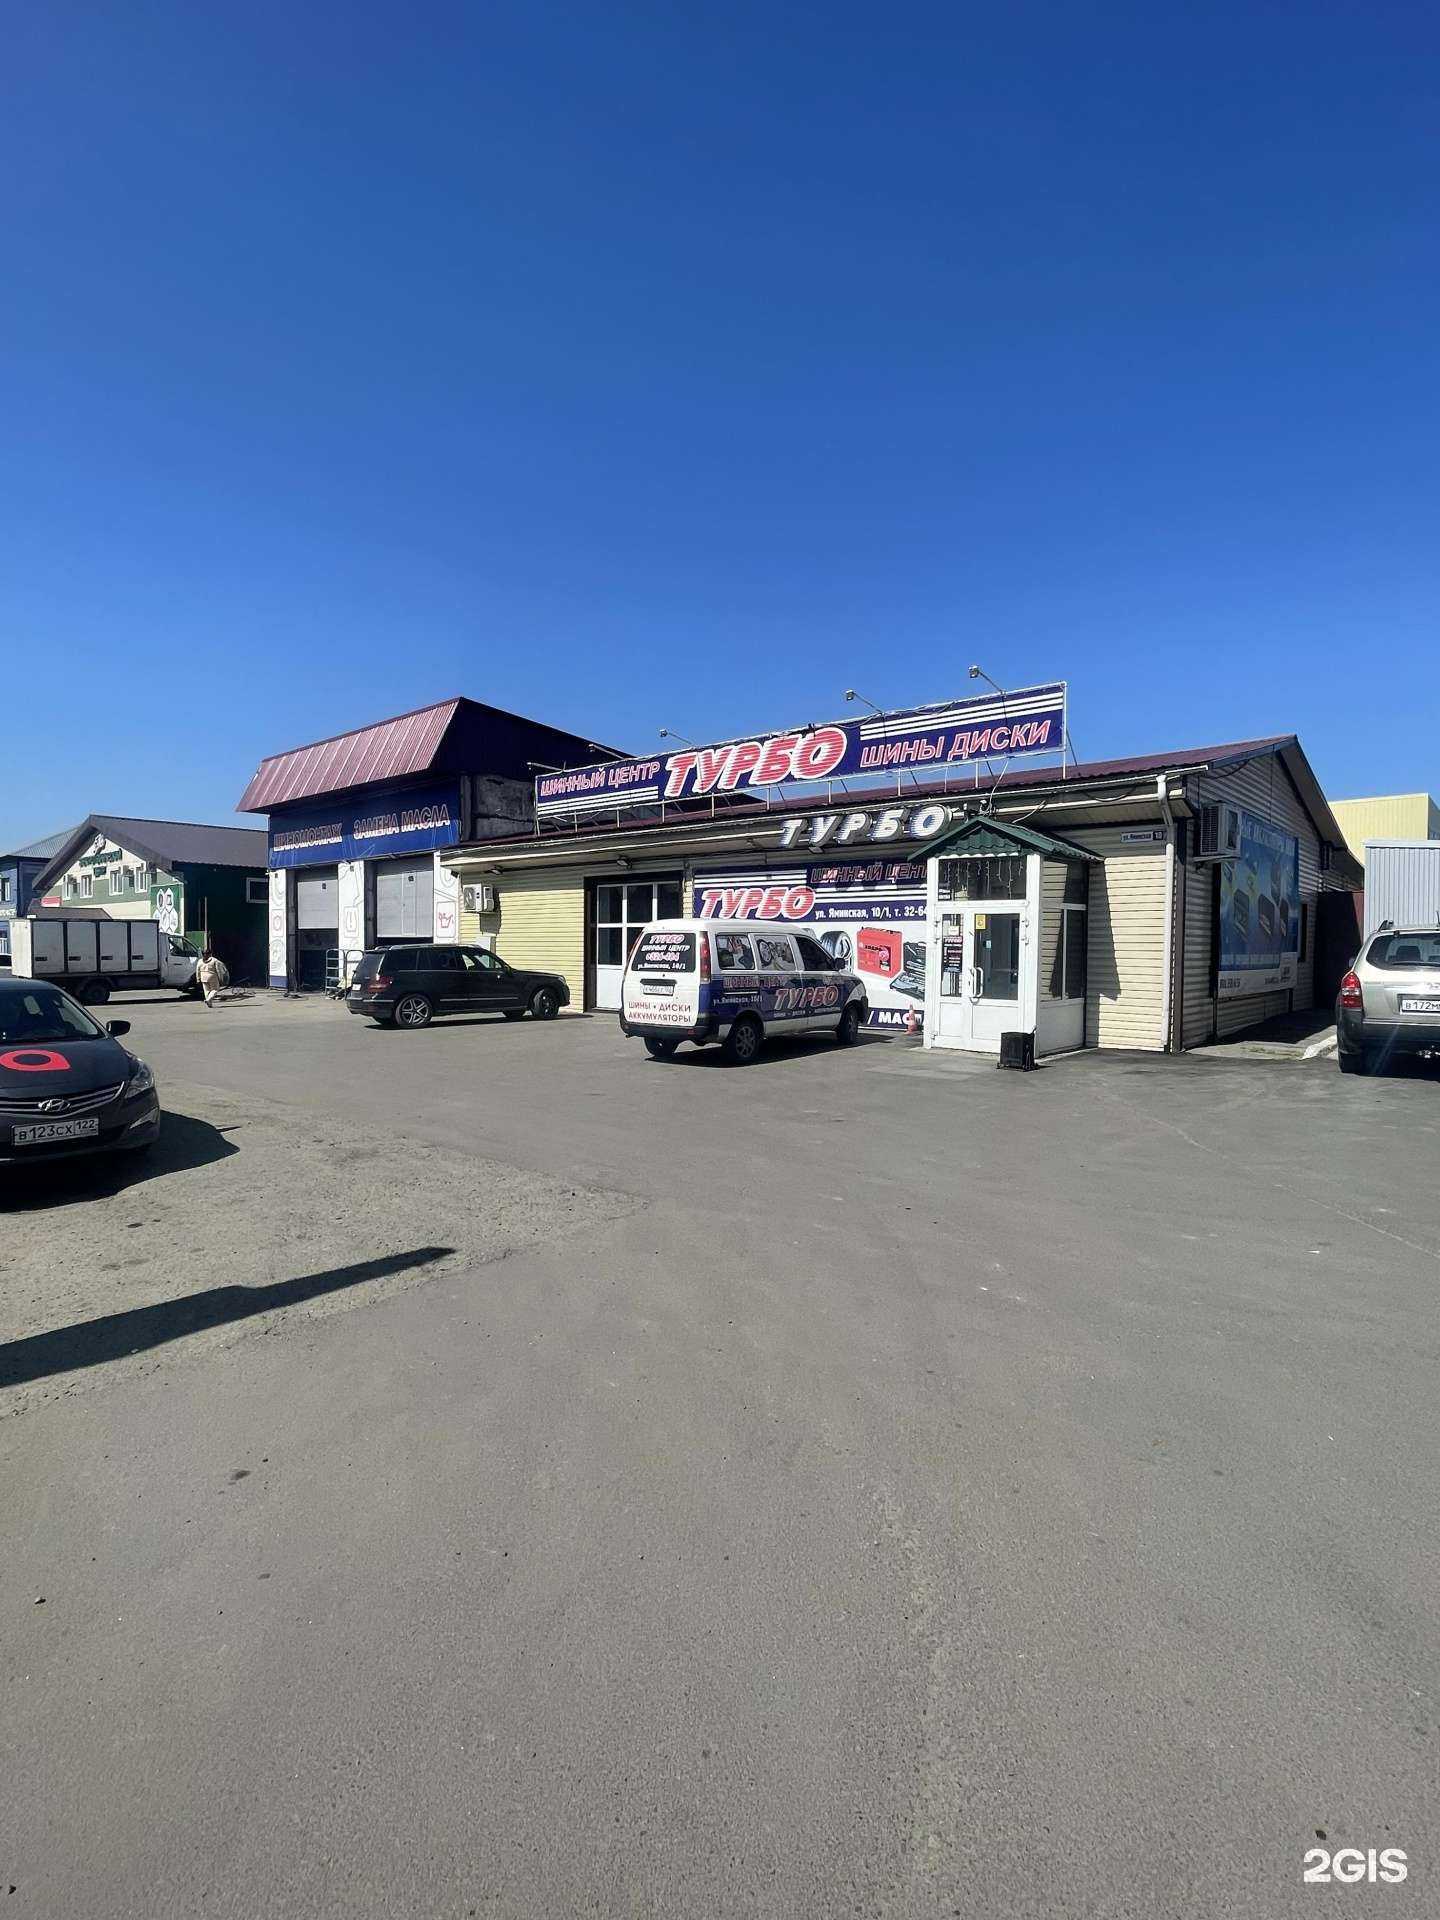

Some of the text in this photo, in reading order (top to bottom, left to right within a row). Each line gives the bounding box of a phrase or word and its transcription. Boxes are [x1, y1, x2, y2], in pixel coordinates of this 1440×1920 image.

[860, 720, 1052, 768] ШИНЫ ДИСКИ
[664, 727, 847, 798] ТУРБО
[540, 761, 660, 796] ШИННЫЙ ЦЕНТР
[353, 804, 451, 840] ЗАМЕНА МАСЛА
[778, 803, 952, 850] ТУРБО
[810, 862, 928, 884] ШИННЫЙ ЦЕН
[700, 885, 816, 920] ТУРБО
[815, 909, 827, 919] ул.
[872, 906, 892, 919] 10/1,
[628, 1001, 691, 1013] ШИНЫ ДИСКИ
[774, 986, 839, 1010] ТУРБО
[1405, 1001, 1440, 1011] В172М
[628, 1011, 691, 1023] АККУМУЛЯТОРЫ
[18, 1119, 95, 1141] В123СХ 122
